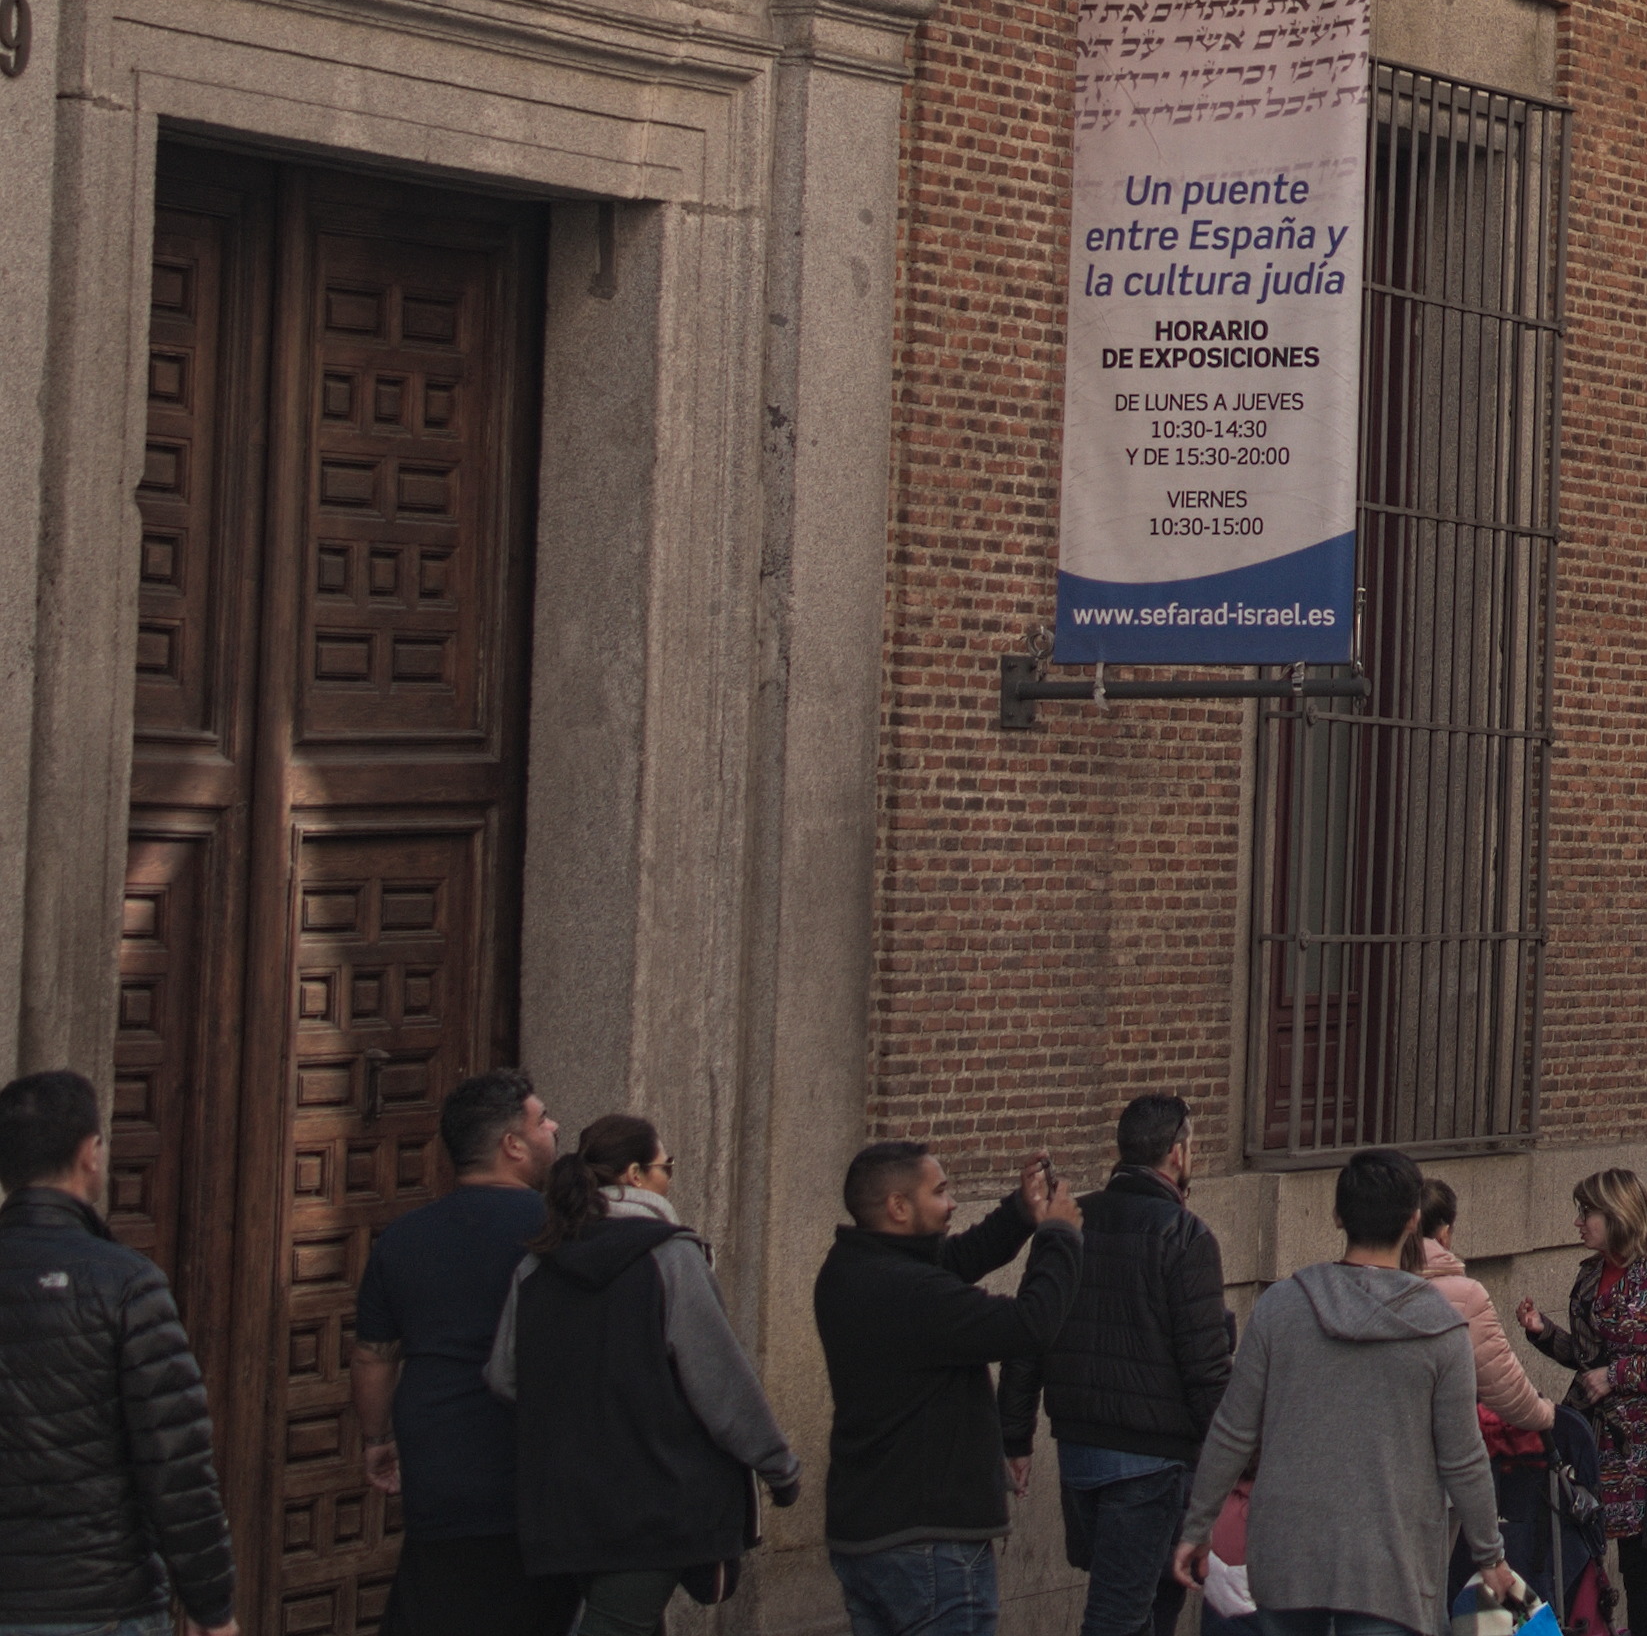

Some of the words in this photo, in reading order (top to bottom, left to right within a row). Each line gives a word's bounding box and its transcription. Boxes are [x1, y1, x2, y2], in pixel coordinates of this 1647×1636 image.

[1125, 175, 1172, 205] Un
[1182, 173, 1310, 214] puente
[1086, 220, 1179, 252] entre
[1189, 216, 1316, 259] España
[1324, 225, 1348, 258] y
[1085, 264, 1113, 296] la
[1124, 263, 1251, 296] cultura
[1256, 261, 1346, 304] judía
[1155, 320, 1269, 341] HORARIO
[1102, 348, 1133, 368] DE
[1139, 346, 1320, 368] EXPOSICIONES
[1115, 394, 1139, 411] DE
[1145, 393, 1208, 411] LUNES
[1213, 393, 1227, 411] A
[1233, 392, 1304, 411] JUEVES
[1151, 420, 1267, 438] 10:30-14:30
[1126, 448, 1138, 465] Y
[1144, 448, 1169, 465] DE
[1175, 447, 1290, 465] 15:30-20:00
[1167, 490, 1248, 508] VIERNES
[1150, 517, 1263, 536] 10:30-15:00
[1073, 602, 1335, 626] www.sefarad-israel.es
